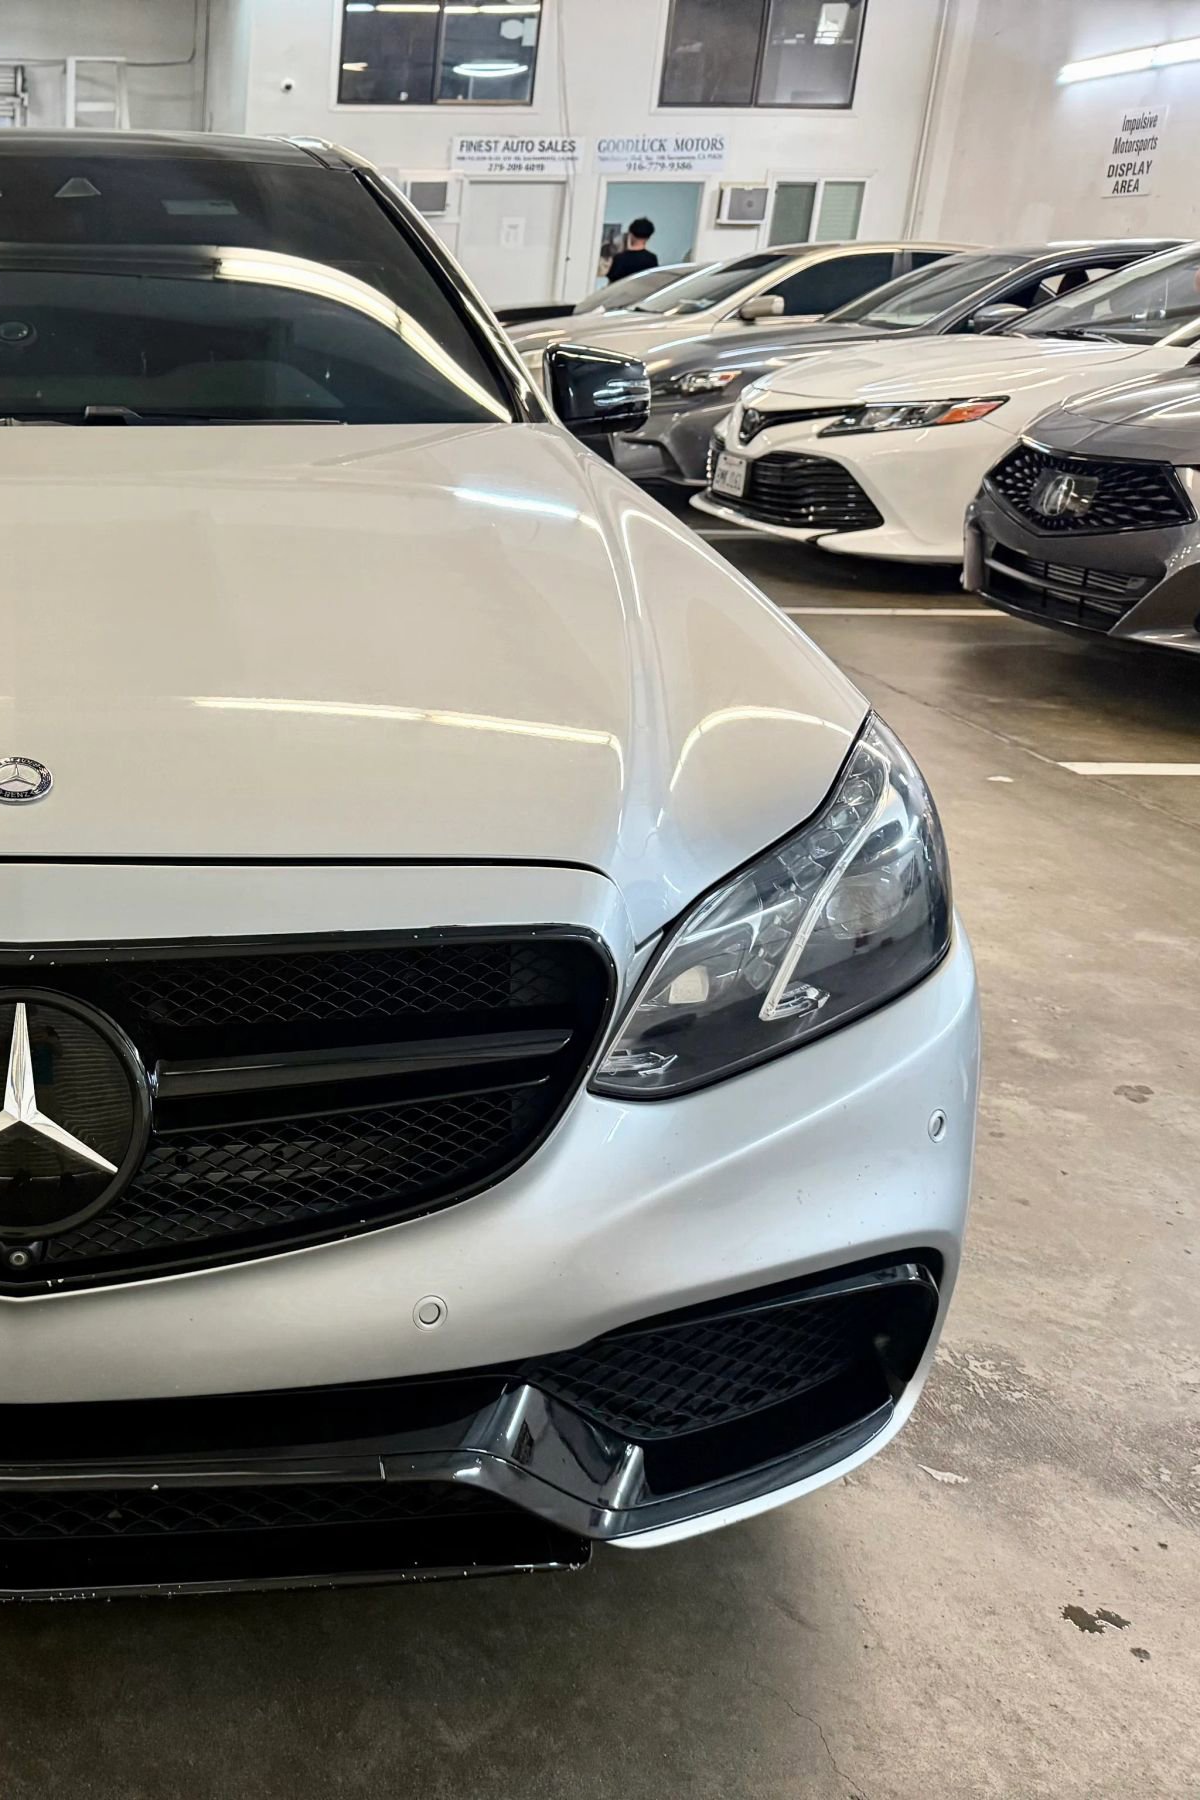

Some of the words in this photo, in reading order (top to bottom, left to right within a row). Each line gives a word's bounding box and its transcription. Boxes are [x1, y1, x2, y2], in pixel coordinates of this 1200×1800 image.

[1121, 111, 1159, 135] Impulsive
[459, 139, 500, 153] FINEST
[502, 139, 535, 153] AUTO
[537, 139, 576, 153] SALES
[597, 138, 667, 153] GOODLUCK
[673, 137, 725, 152] MOTORS
[1112, 135, 1159, 156] Motorsports
[1107, 160, 1153, 178] DISPLAY
[1112, 178, 1140, 195] AREA
